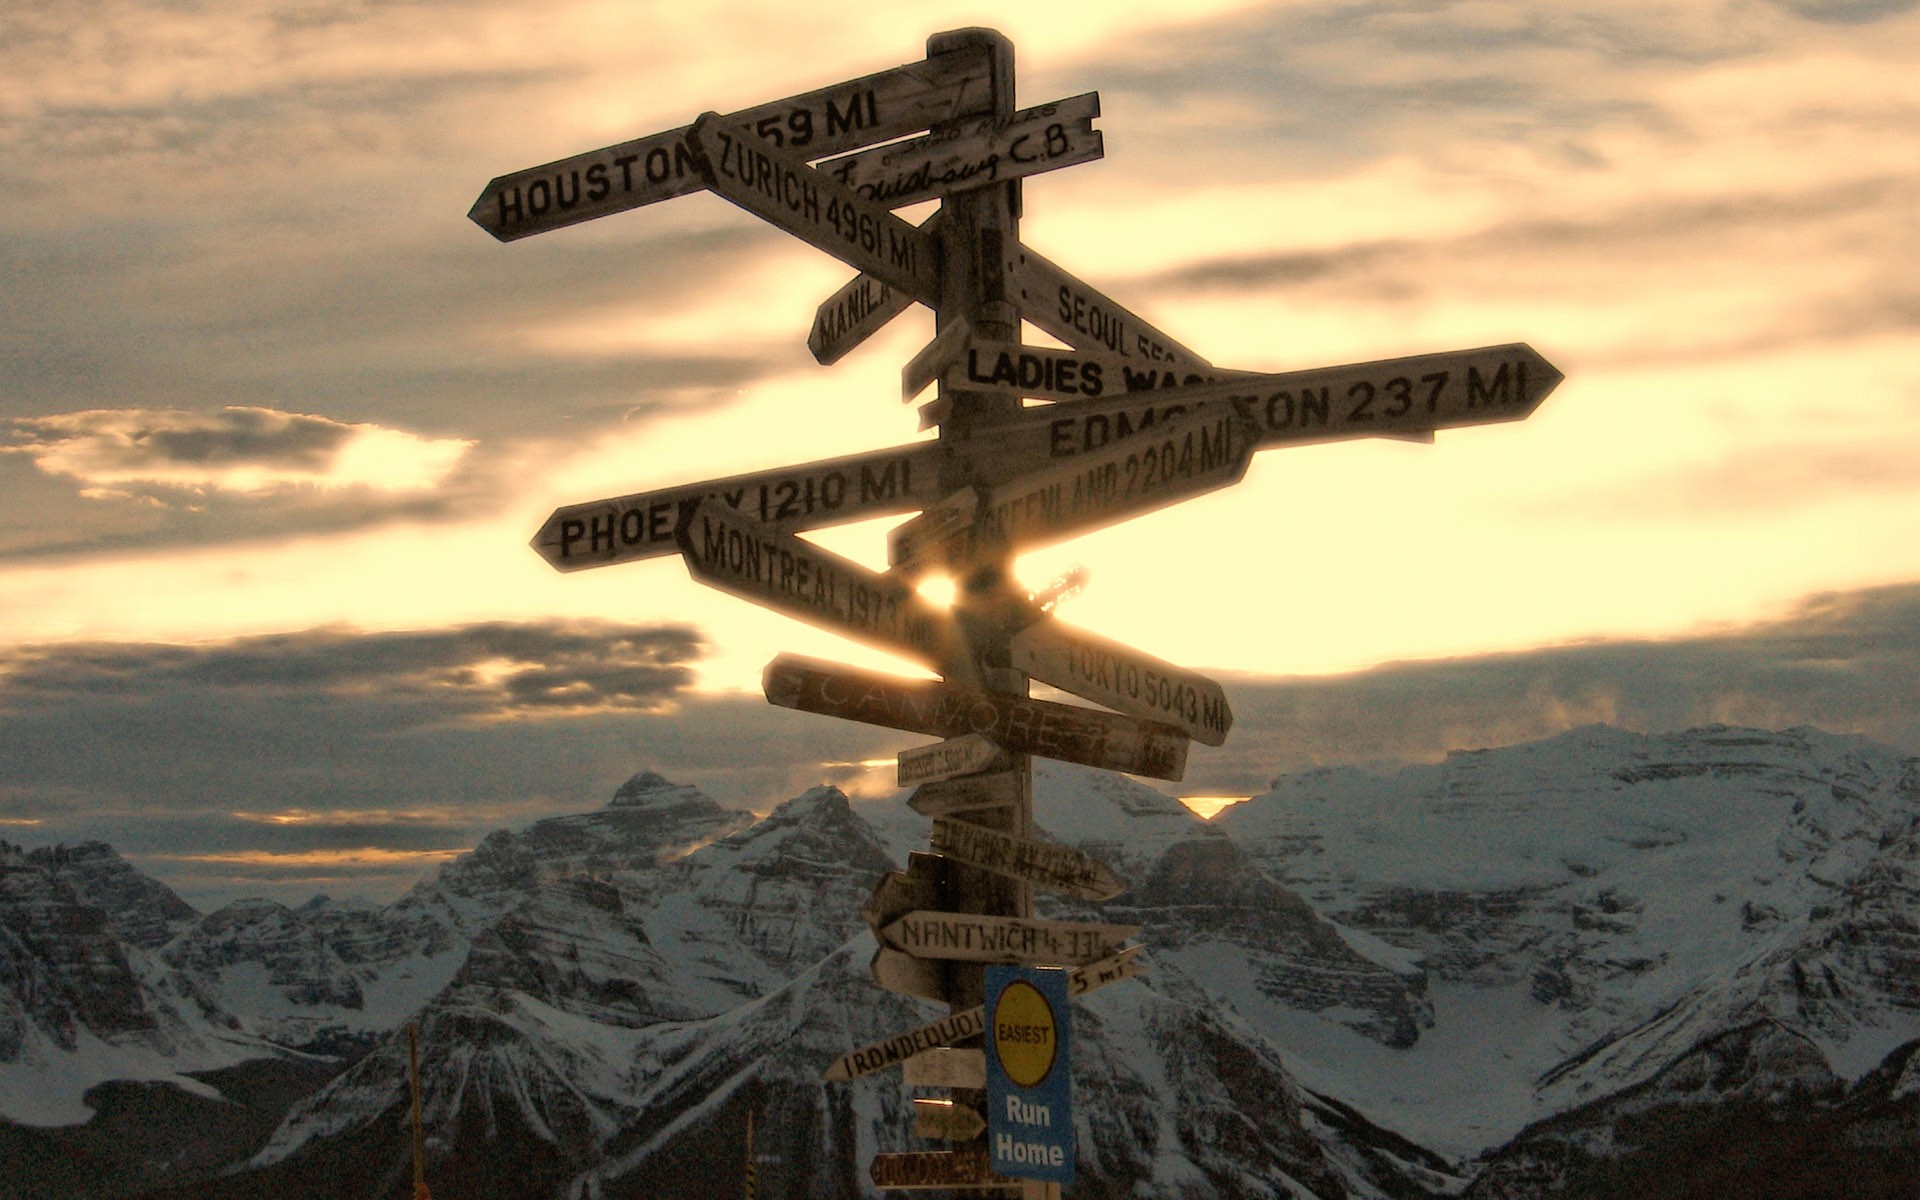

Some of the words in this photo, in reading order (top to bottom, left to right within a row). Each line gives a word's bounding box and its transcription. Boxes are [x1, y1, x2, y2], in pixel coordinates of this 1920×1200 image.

[498, 140, 702, 227] HOUSTON
[826, 89, 881, 136] MI
[717, 130, 820, 225] ZURICH
[826, 199, 882, 259] 4961
[890, 226, 917, 279] MI
[1058, 285, 1131, 357] SEOUL
[967, 348, 1104, 396] LADIES
[1346, 370, 1448, 423] 237
[1466, 352, 1529, 410] MI
[759, 471, 848, 522] 1210
[860, 459, 912, 504] MI
[1124, 430, 1193, 497] 2204
[1200, 416, 1232, 475] MI
[703, 515, 843, 611] MONTREAL
[820, 672, 1062, 752] CANMORE
[1067, 640, 1140, 700] TOKYO
[1144, 673, 1198, 724] 5043
[1203, 695, 1226, 733] MI
[901, 919, 1037, 955] NANTWICH
[998, 1025, 1050, 1046] EASIEST
[1006, 1094, 1051, 1127] Run
[995, 1133, 1065, 1167] Home
